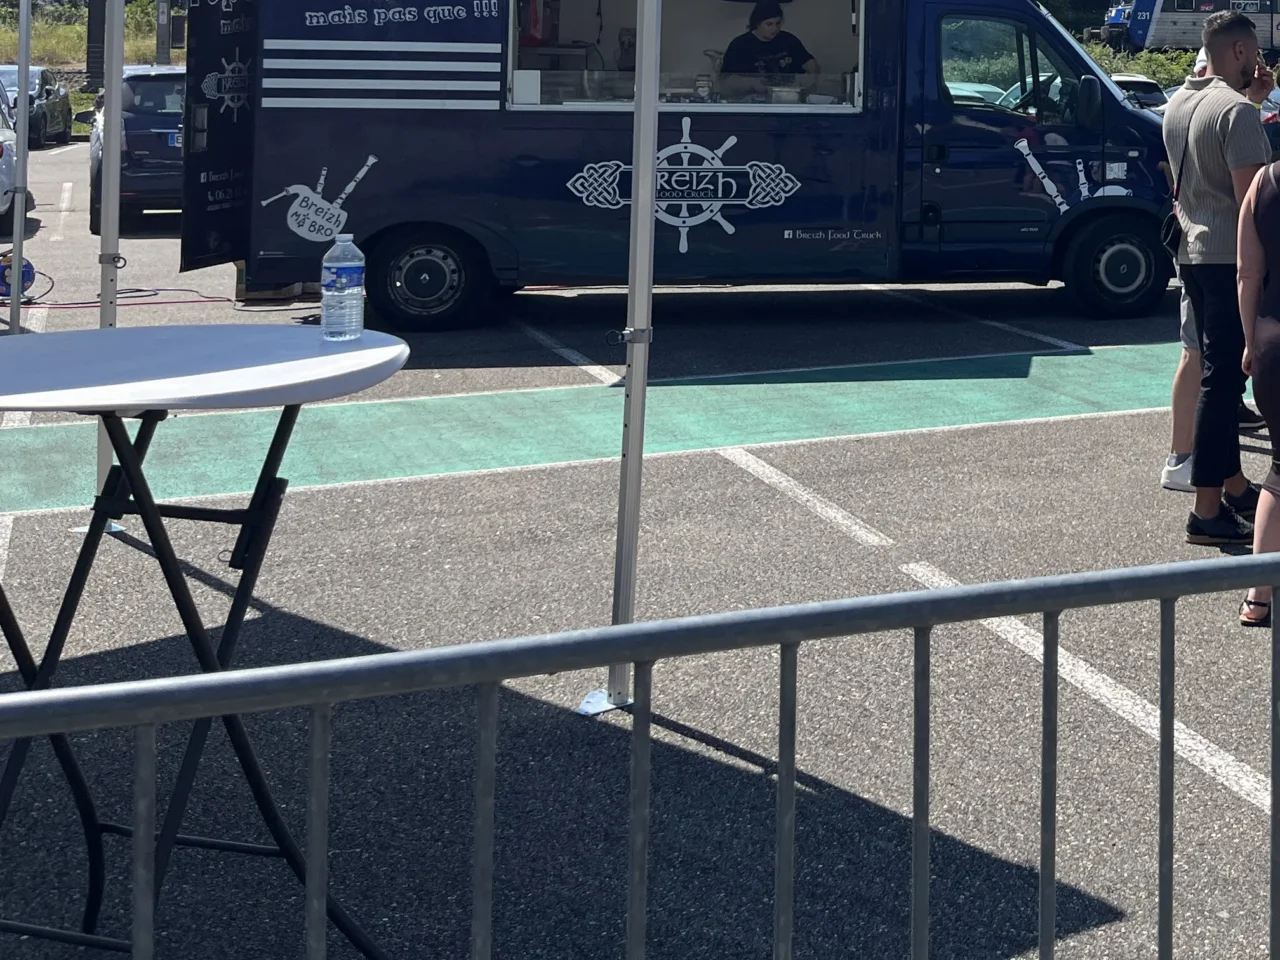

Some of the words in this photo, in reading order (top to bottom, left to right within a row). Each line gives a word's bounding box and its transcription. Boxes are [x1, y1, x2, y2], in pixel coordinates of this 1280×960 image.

[305, 5, 368, 26] mais
[373, 7, 418, 26] pas
[424, 5, 467, 23] que
[1137, 11, 1150, 20] 231
[655, 171, 737, 199] REIZH
[299, 196, 342, 228] Breizh
[308, 220, 334, 237] BRO
